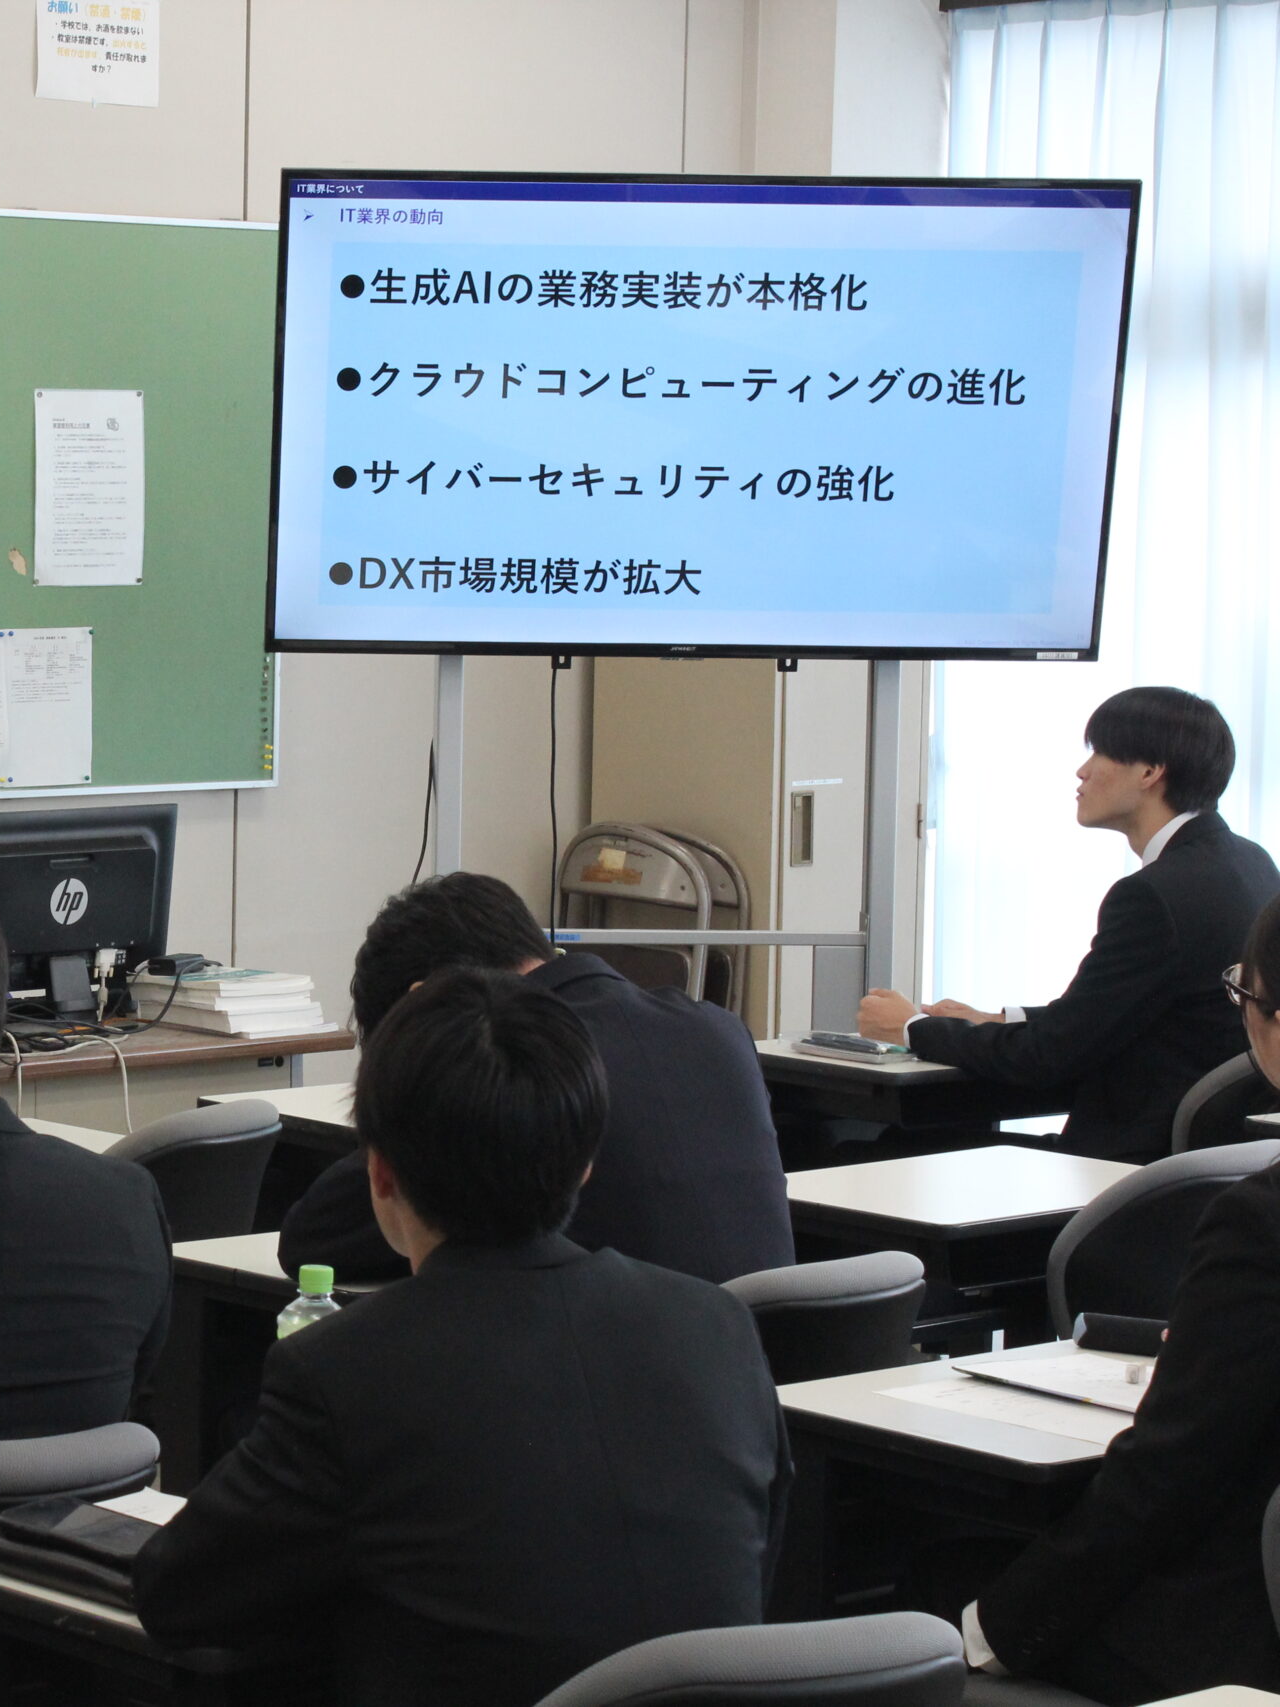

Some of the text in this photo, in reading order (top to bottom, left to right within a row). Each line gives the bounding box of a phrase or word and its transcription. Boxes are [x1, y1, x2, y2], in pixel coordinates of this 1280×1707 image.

[296, 183, 365, 195] IT業界について
[340, 207, 444, 225] IT業界の動向
[369, 266, 869, 313] 生成AIの業務実装が本格化
[369, 360, 1027, 407] クラウドコンピューティングの進化
[362, 458, 895, 504] サイバーセキュリティの強化
[358, 554, 703, 597] DX市場規模が拡大
[54, 878, 85, 925] hp
